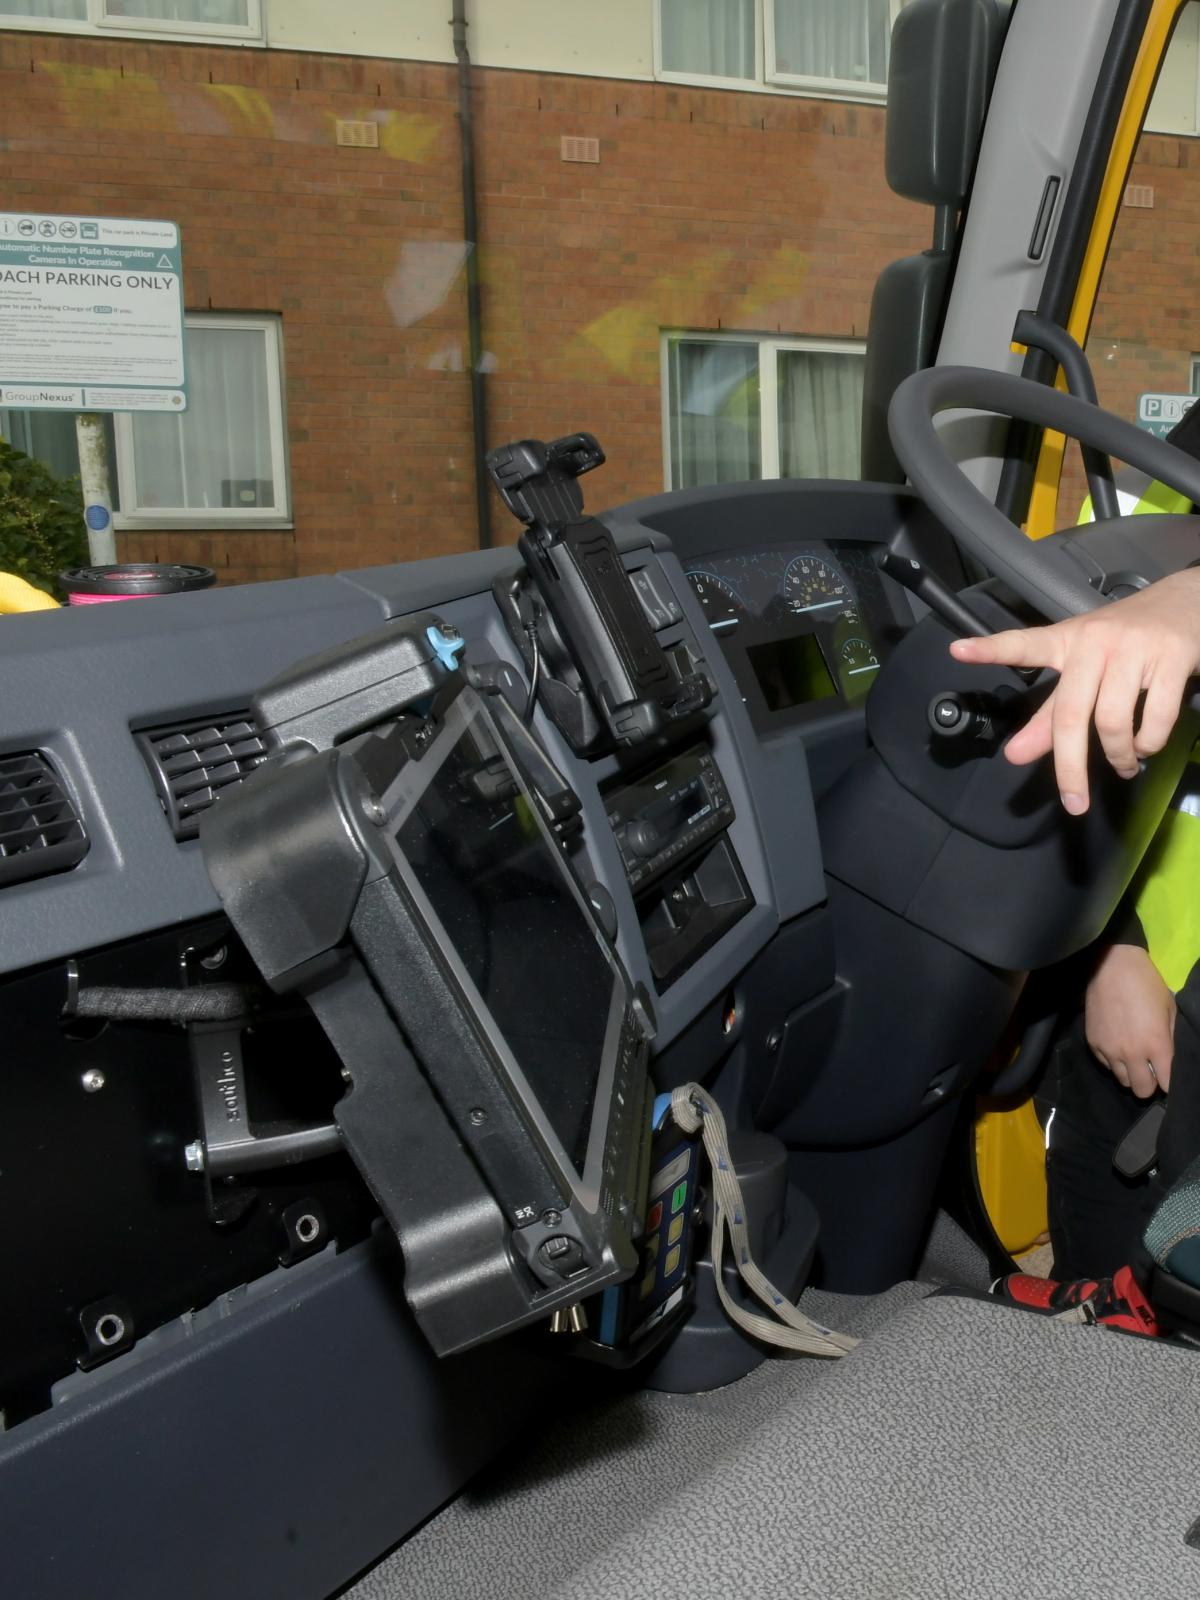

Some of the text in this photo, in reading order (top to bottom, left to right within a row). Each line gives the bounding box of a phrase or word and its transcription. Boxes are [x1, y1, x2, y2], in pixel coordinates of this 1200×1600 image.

[42, 244, 78, 254] Number
[80, 246, 102, 255] Plate
[103, 247, 155, 258] Recognition
[28, 254, 122, 267] Cameras In Operation
[0, 270, 173, 290] ACH PARKING ONLY
[217, 1051, 241, 1122] southco
